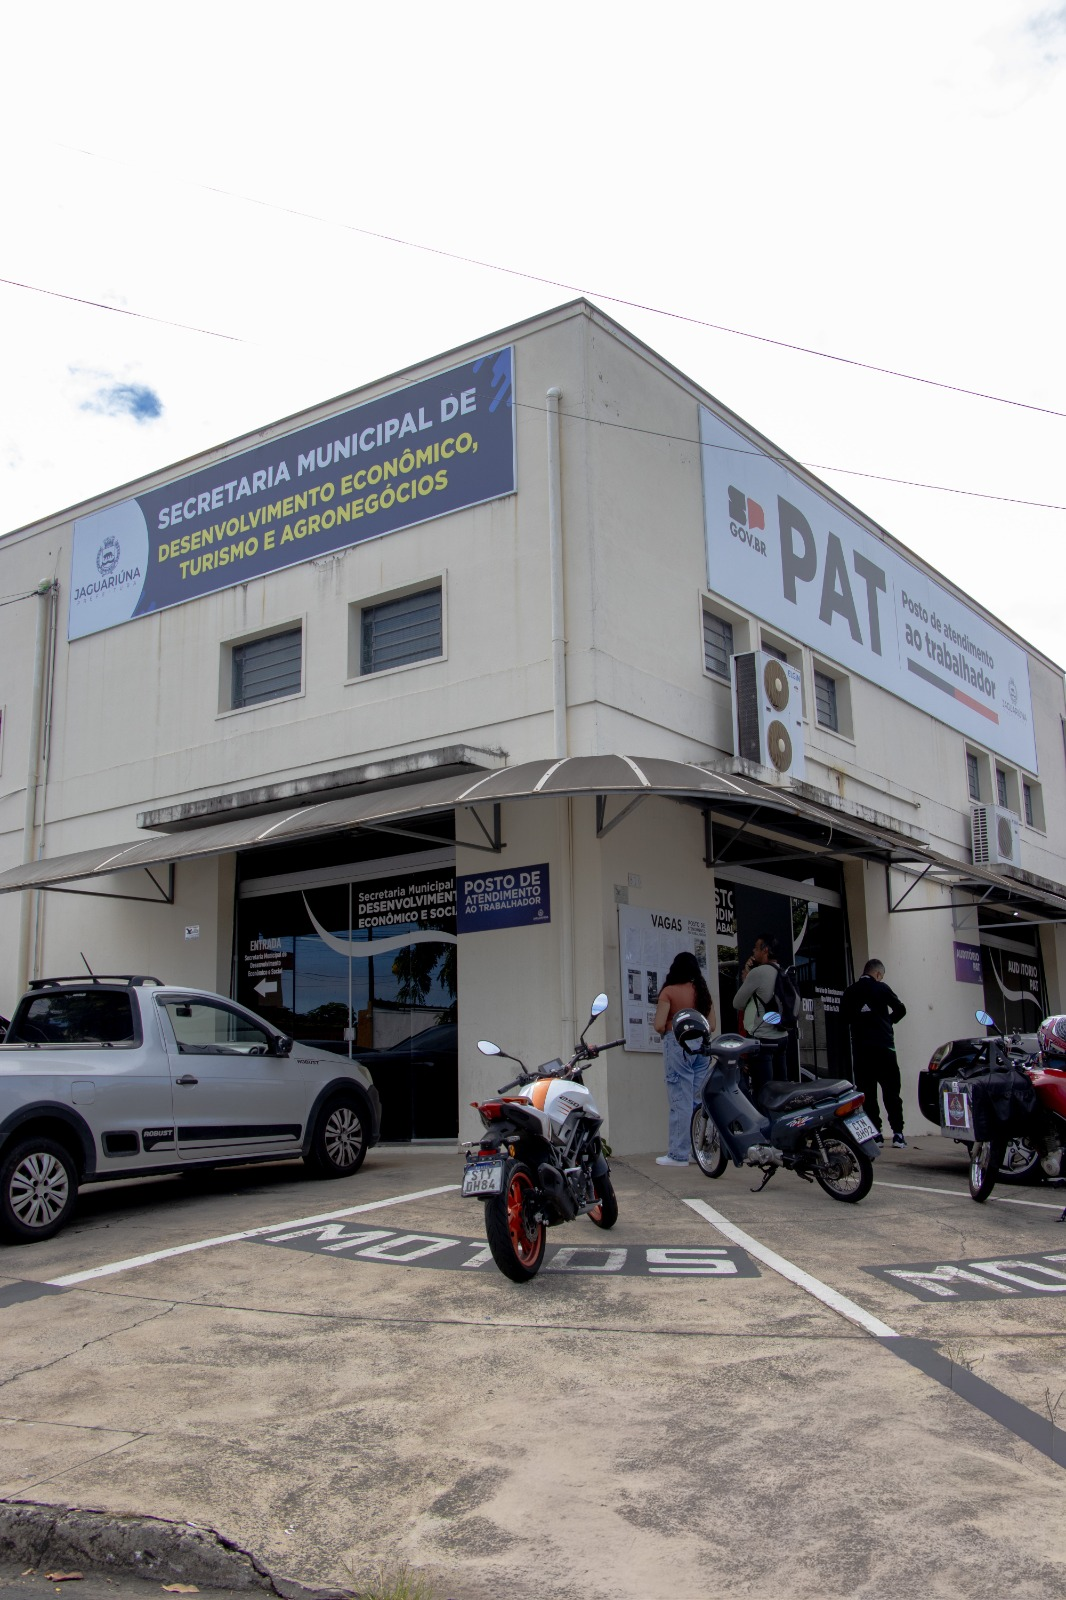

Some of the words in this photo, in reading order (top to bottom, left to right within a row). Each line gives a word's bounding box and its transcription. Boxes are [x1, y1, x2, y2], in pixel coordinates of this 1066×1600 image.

[158, 461, 290, 530] SECRETARIA
[297, 407, 434, 478] MUNICIPAL
[440, 388, 477, 423] DE
[158, 482, 335, 563] DESENVOLVIMENTO
[340, 432, 479, 496] ECONÔMICO,
[179, 539, 259, 580] TURISMO
[263, 532, 275, 551] E
[280, 469, 449, 542] AGRONEGÓCIOS
[728, 522, 767, 558] GOV.BR
[73, 566, 141, 601] JAGUARIÚNA
[777, 494, 887, 657] PAT
[901, 589, 928, 624] Posto
[930, 611, 942, 632] de
[943, 618, 995, 670] atendimento
[904, 623, 923, 652] ao
[924, 631, 997, 700] trabalhador
[358, 887, 406, 902] Secretaria
[408, 878, 454, 899] Municipal
[464, 874, 516, 895] POSTO
[520, 870, 541, 886] DE
[465, 885, 541, 906] ATENDIMENTO
[358, 908, 418, 929] ECONÔMICO
[421, 909, 428, 921] E
[429, 902, 458, 919] SOCI
[465, 904, 477, 914] AO
[479, 896, 541, 912] TRABALHADOR
[651, 914, 683, 932] VAGAS
[250, 938, 282, 952] ENTRADA
[143, 1129, 173, 1138] ROBUST
[471, 1168, 493, 1181] STY
